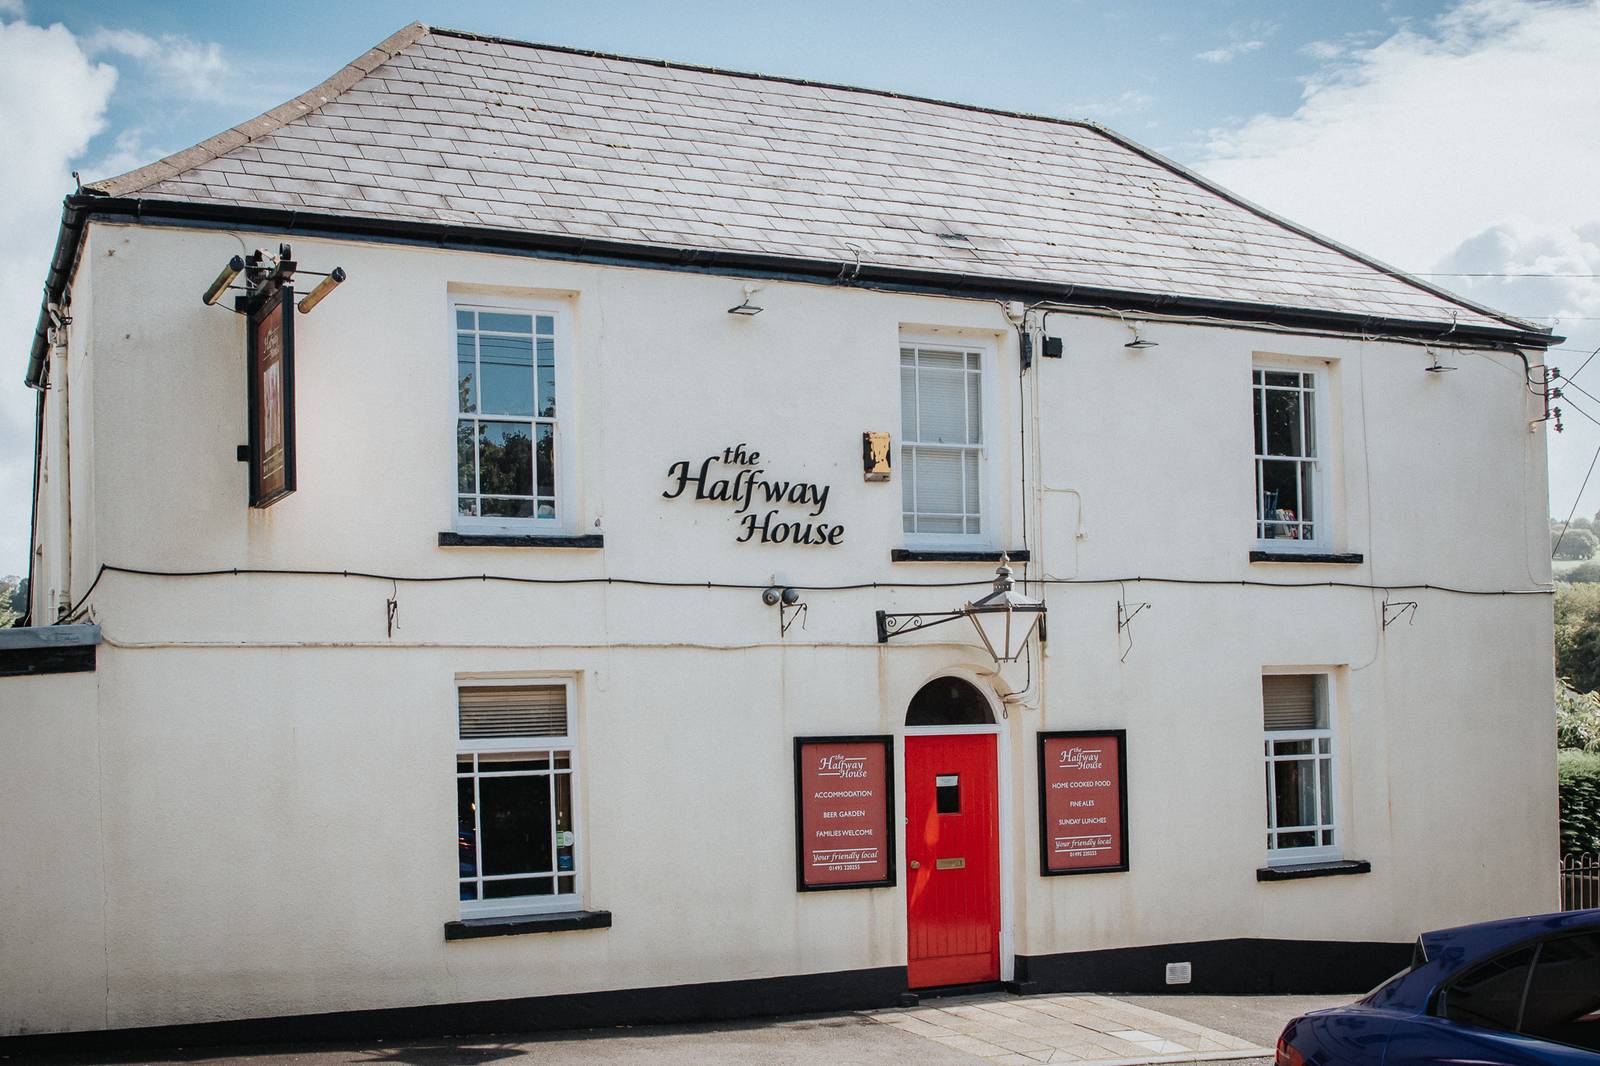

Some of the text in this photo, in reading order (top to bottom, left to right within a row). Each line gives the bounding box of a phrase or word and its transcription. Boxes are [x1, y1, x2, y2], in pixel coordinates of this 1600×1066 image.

[723, 443, 760, 465] the
[662, 456, 830, 516] Halfway
[736, 510, 844, 545] House
[1059, 748, 1099, 764] Halfway
[818, 755, 864, 772] Halfway
[1077, 761, 1102, 770] House
[839, 769, 868, 778] House
[1051, 781, 1069, 789] HOME
[1069, 780, 1094, 788] COOKED
[814, 790, 873, 799] ACCOMMODATION
[1082, 799, 1095, 807] ALES
[823, 810, 866, 819] BEER GARDEN
[1058, 817, 1107, 826] SUNDAY LUNCHES
[842, 829, 873, 837] WELCOME
[1055, 837, 1112, 849] Your friendly local
[812, 850, 879, 863] Your friendly local
